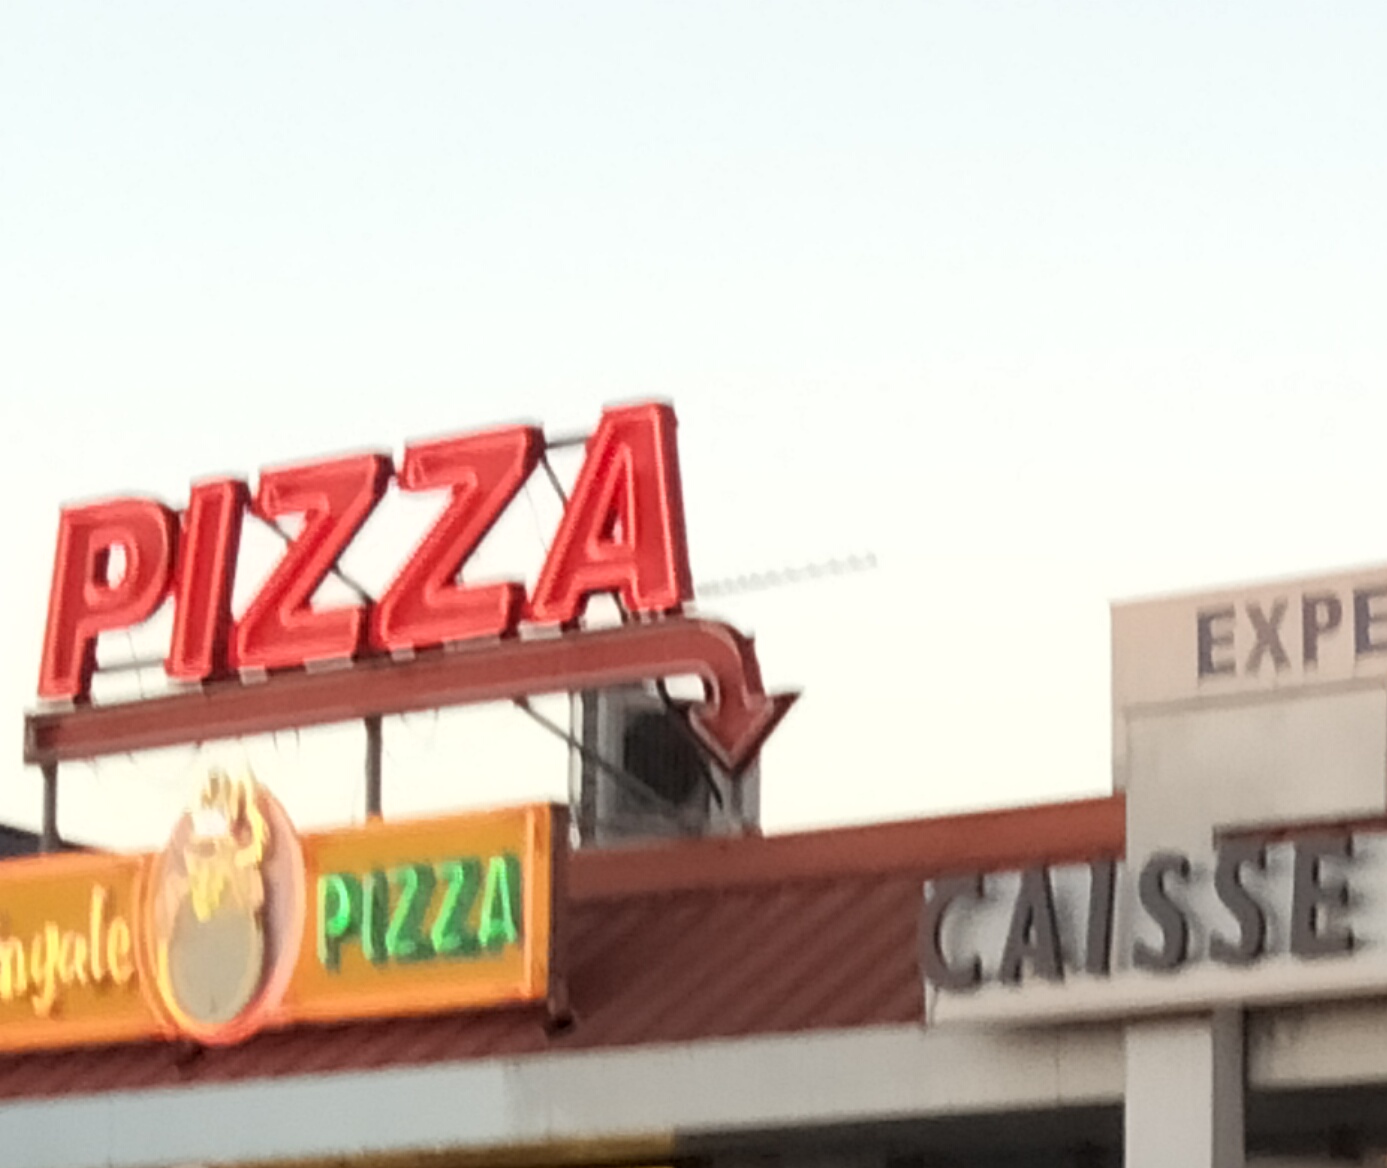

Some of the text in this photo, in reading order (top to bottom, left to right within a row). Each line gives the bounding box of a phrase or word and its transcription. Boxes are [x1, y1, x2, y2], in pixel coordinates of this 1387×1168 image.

[38, 398, 692, 702] PIZZA
[316, 856, 520, 970] PIZZA
[920, 832, 1355, 990] CAISSE
